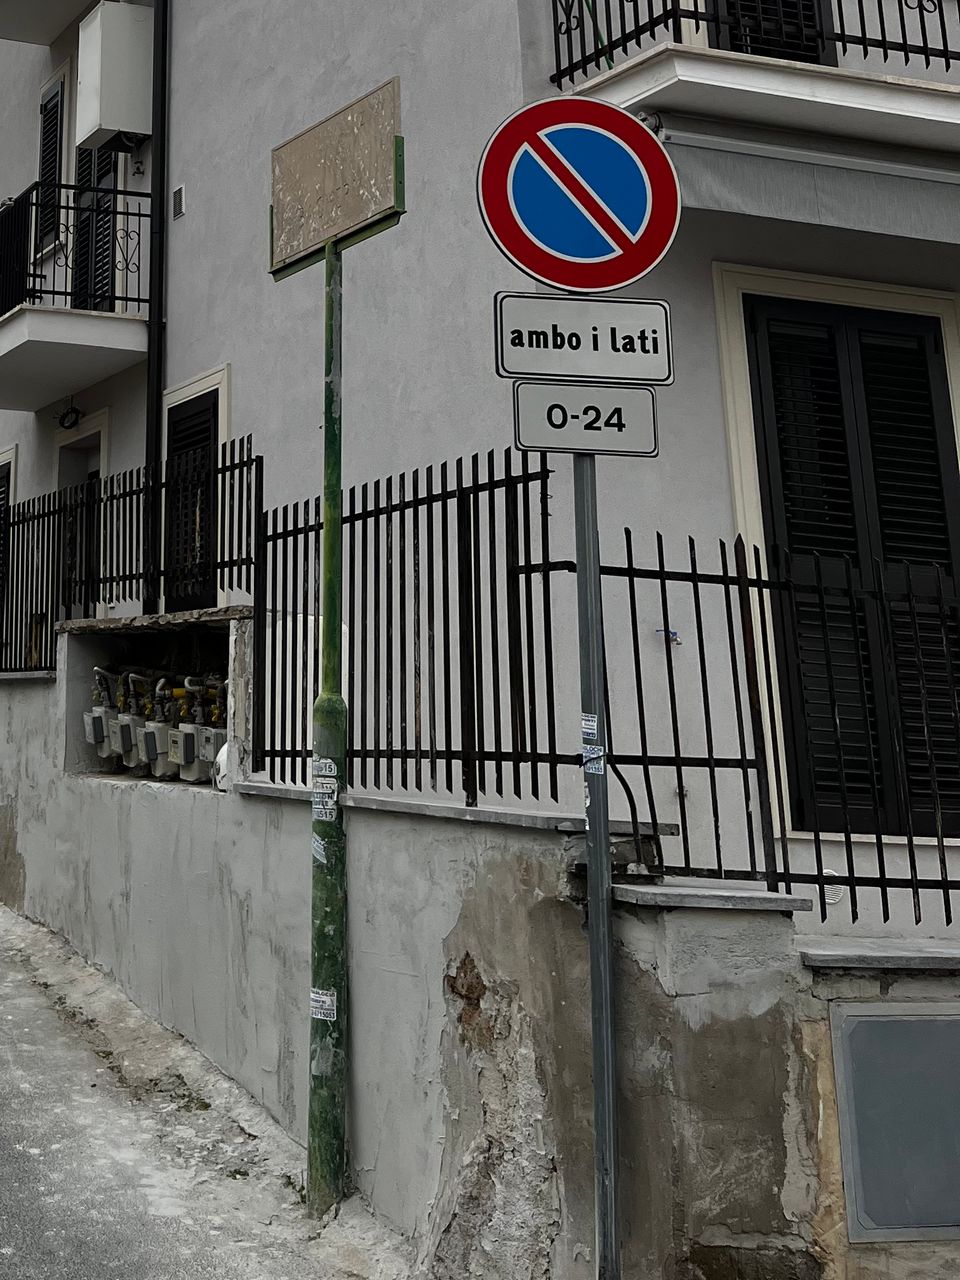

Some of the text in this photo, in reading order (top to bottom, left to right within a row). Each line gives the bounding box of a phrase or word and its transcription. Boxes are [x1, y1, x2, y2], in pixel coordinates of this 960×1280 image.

[510, 324, 659, 354] ambo i lati
[546, 403, 626, 433] 0-24
